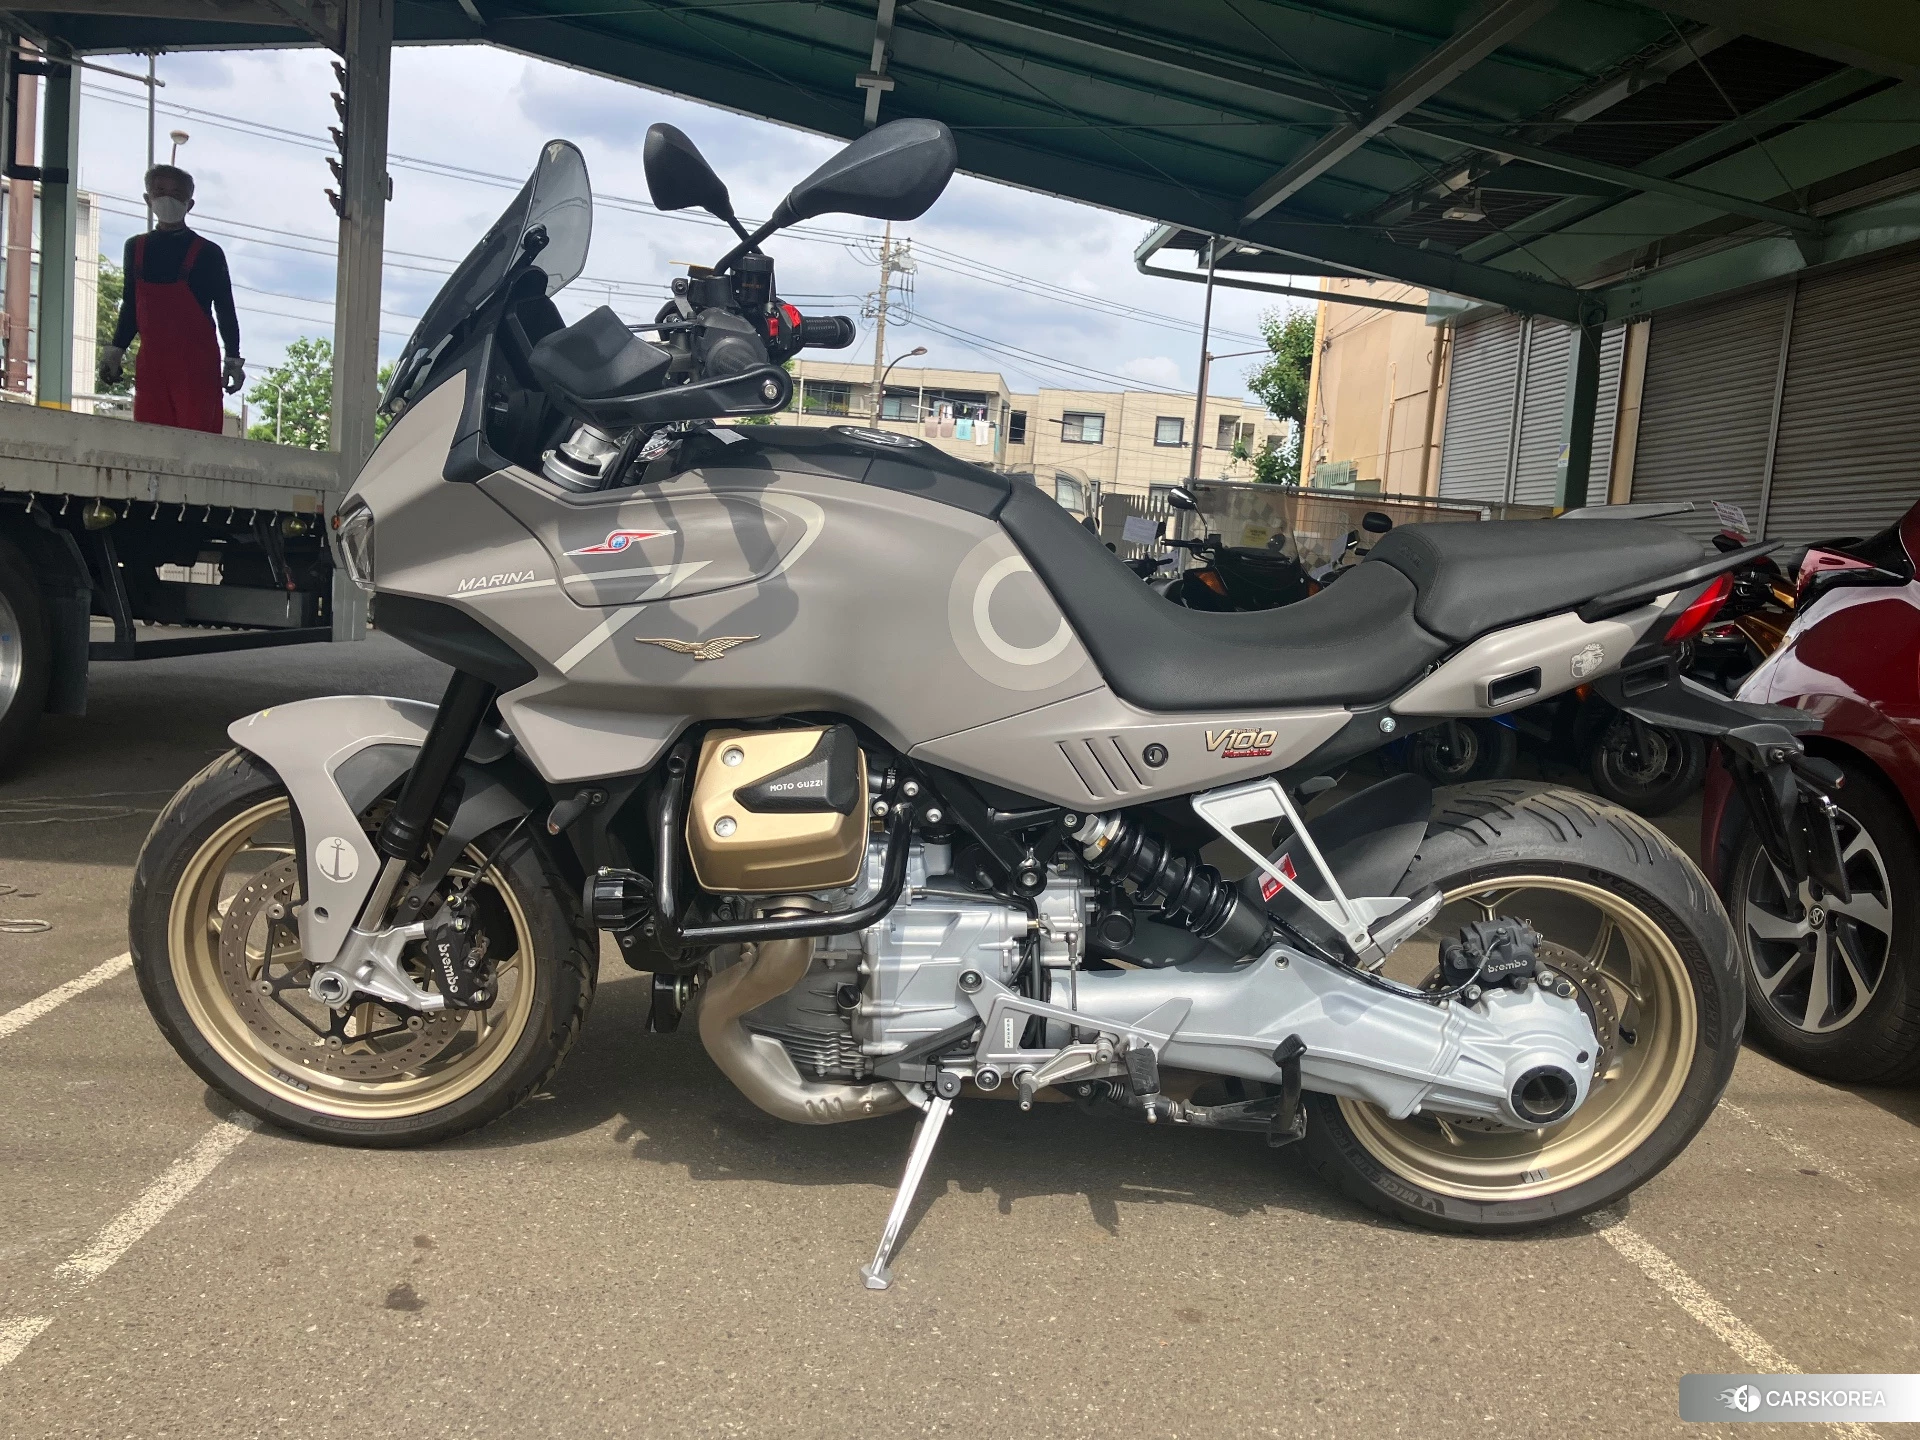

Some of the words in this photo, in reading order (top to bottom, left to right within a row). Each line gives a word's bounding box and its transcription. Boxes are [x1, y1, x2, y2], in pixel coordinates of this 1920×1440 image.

[458, 570, 535, 592] MARINA
[1205, 730, 1278, 751] V100
[770, 783, 794, 792] MOTO
[797, 779, 823, 788] GUZZI
[1613, 879, 1686, 940] MICHELIN
[437, 943, 459, 993] brembo
[1488, 960, 1527, 973] brembo
[1351, 1151, 1419, 1203] MICHELIN
